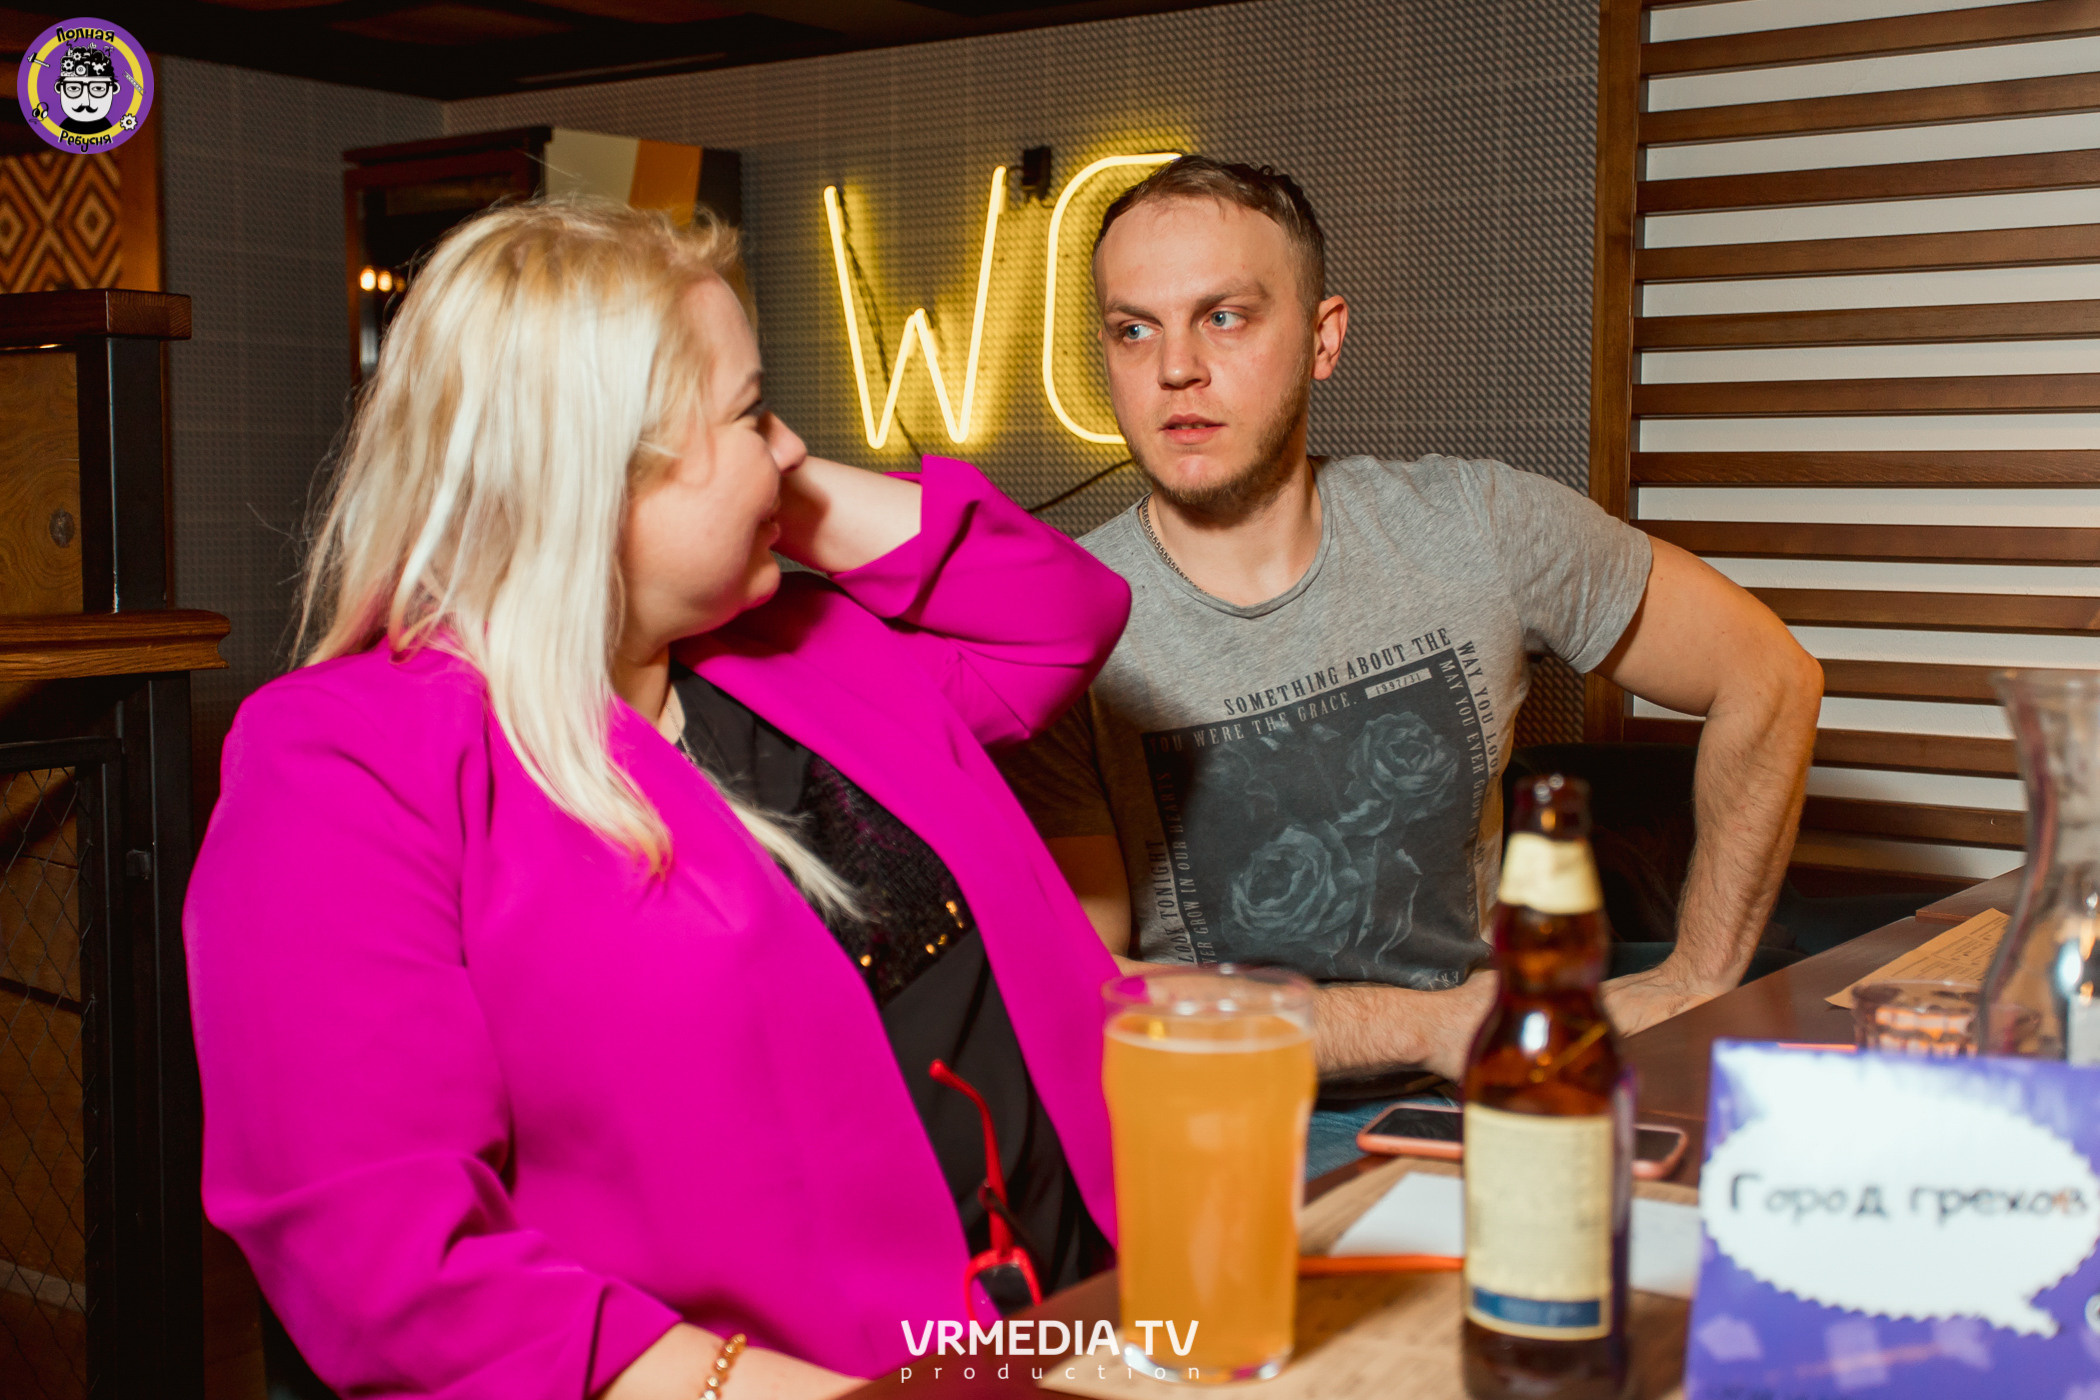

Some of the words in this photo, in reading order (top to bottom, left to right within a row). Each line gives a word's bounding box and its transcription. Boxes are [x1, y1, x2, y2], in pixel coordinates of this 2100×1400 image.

[823, 152, 1182, 449] WC
[1223, 666, 1339, 716] SOMETHING
[1347, 644, 1406, 680] ABOUT
[1411, 627, 1451, 655] THE
[1457, 640, 1483, 678] WAY
[1474, 686, 1494, 724] YOU
[1149, 735, 1182, 755] YOU
[1193, 723, 1245, 748] WERE
[1251, 712, 1289, 735] THE
[1297, 691, 1357, 722] GRACE.
[1439, 659, 1464, 690] MAY
[1455, 696, 1476, 727] YOU
[1466, 732, 1485, 774] EVER
[1145, 839, 1178, 921] TONIGHT
[1172, 840, 1191, 872] OUR
[1179, 877, 1197, 894] IN
[1165, 926, 1195, 964] LOOK
[1183, 900, 1209, 935] GROW
[1730, 1173, 1890, 1225] Город
